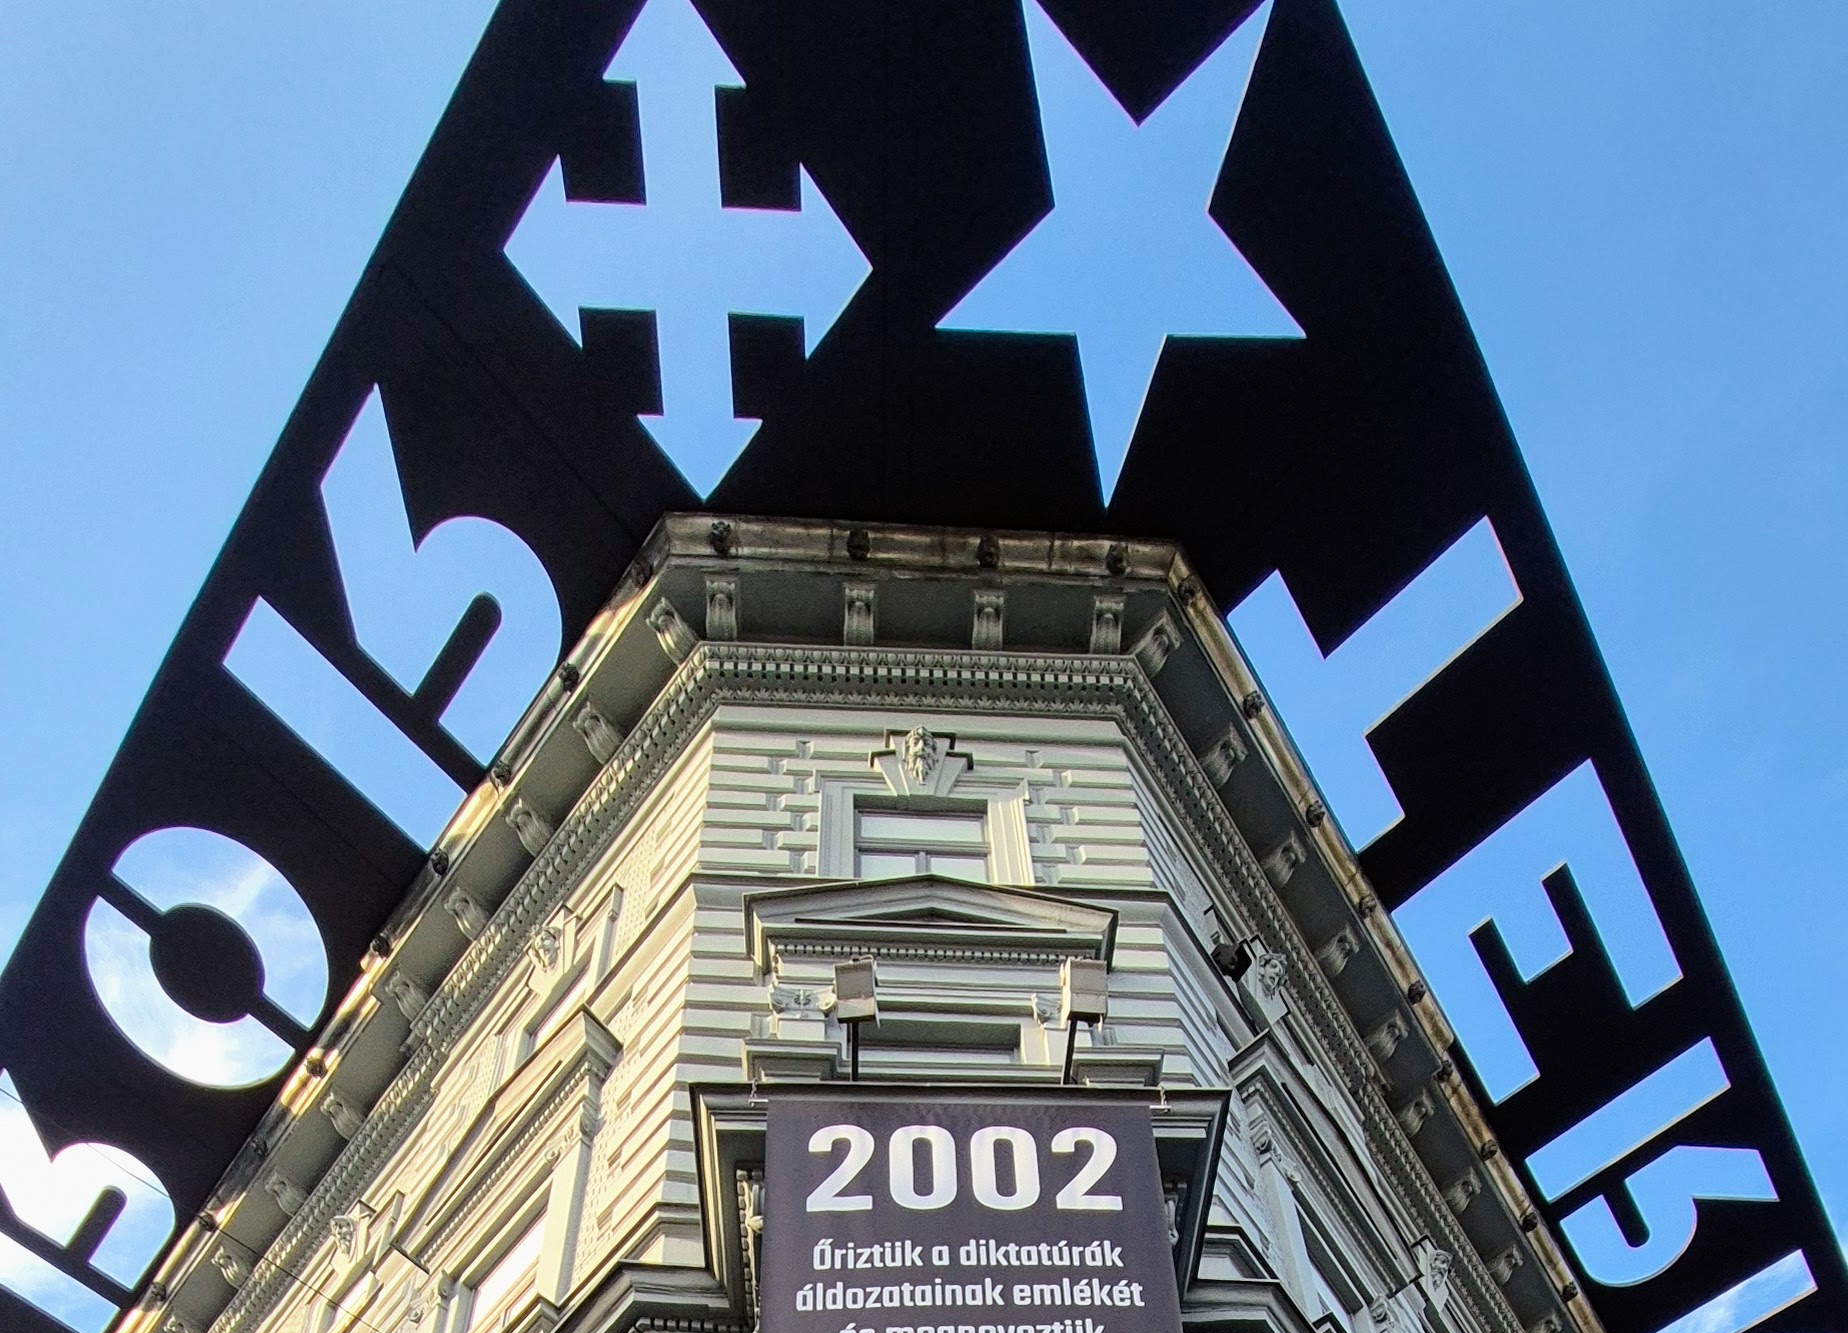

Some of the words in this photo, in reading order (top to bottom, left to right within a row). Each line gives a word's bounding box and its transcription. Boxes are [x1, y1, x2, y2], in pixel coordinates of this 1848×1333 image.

[805, 1124, 1123, 1213] 2002
[812, 1238, 924, 1271] Őriztük
[931, 1244, 951, 1267] a
[959, 1238, 1125, 1269] diktatúrák
[795, 1277, 1005, 1312] áldozatainak
[1012, 1277, 1146, 1308] emlékét
